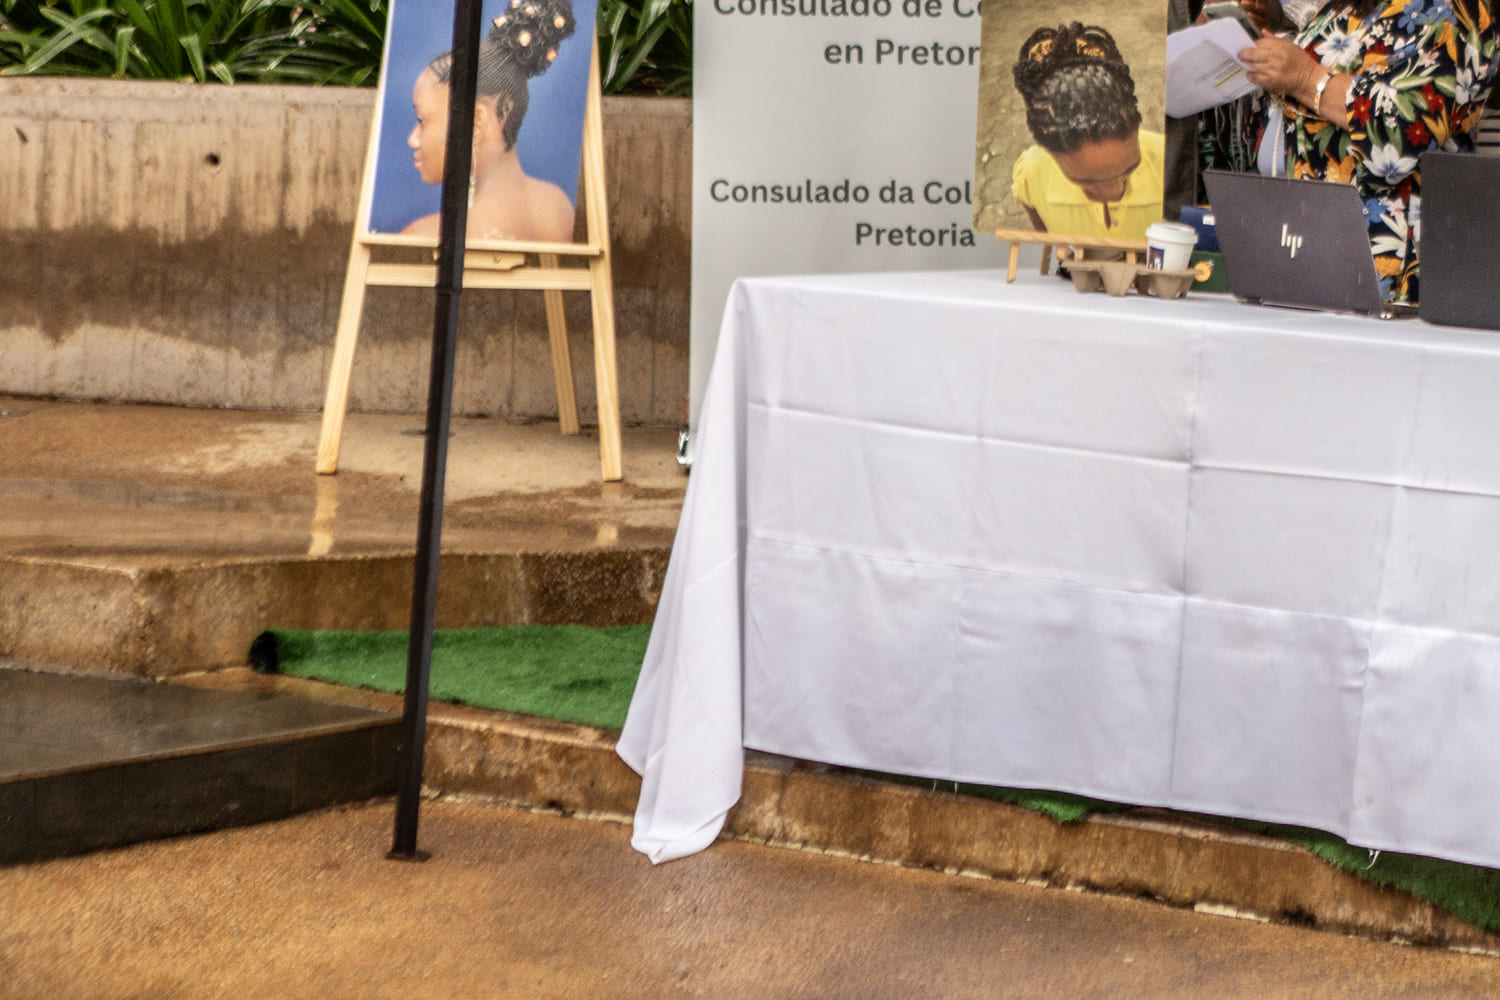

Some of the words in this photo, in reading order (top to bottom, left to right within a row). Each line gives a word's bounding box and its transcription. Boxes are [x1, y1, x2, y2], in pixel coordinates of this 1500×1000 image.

[823, 43, 864, 65] en
[710, 178, 870, 204] Consulado
[878, 179, 915, 205] da
[855, 222, 977, 248] Pretoria
[1281, 223, 1304, 259] hp
